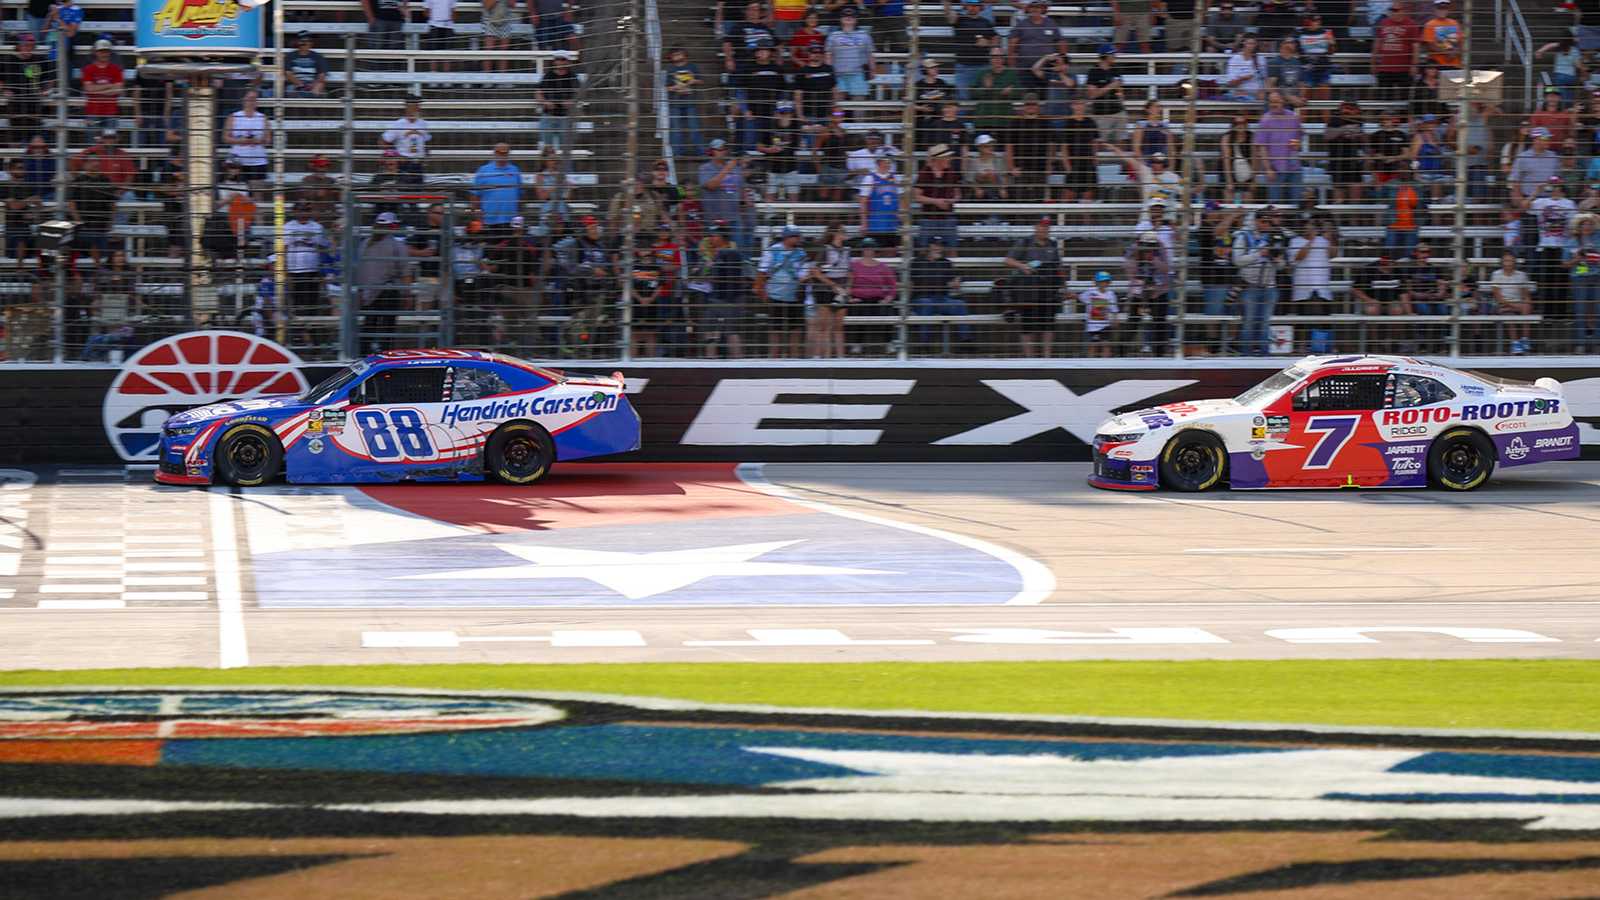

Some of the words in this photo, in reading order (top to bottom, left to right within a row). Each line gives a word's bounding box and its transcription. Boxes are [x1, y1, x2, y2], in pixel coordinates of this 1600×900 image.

[225, 414, 268, 426] GOODYEAR
[1501, 421, 1527, 430] PICOTE
[354, 409, 435, 459] 88
[1391, 425, 1428, 436] RIDGID
[1303, 415, 1361, 470] 7
[1533, 436, 1574, 448] BRANDT
[1384, 444, 1427, 455] JARRETT
[1391, 456, 1422, 470] Tufco
